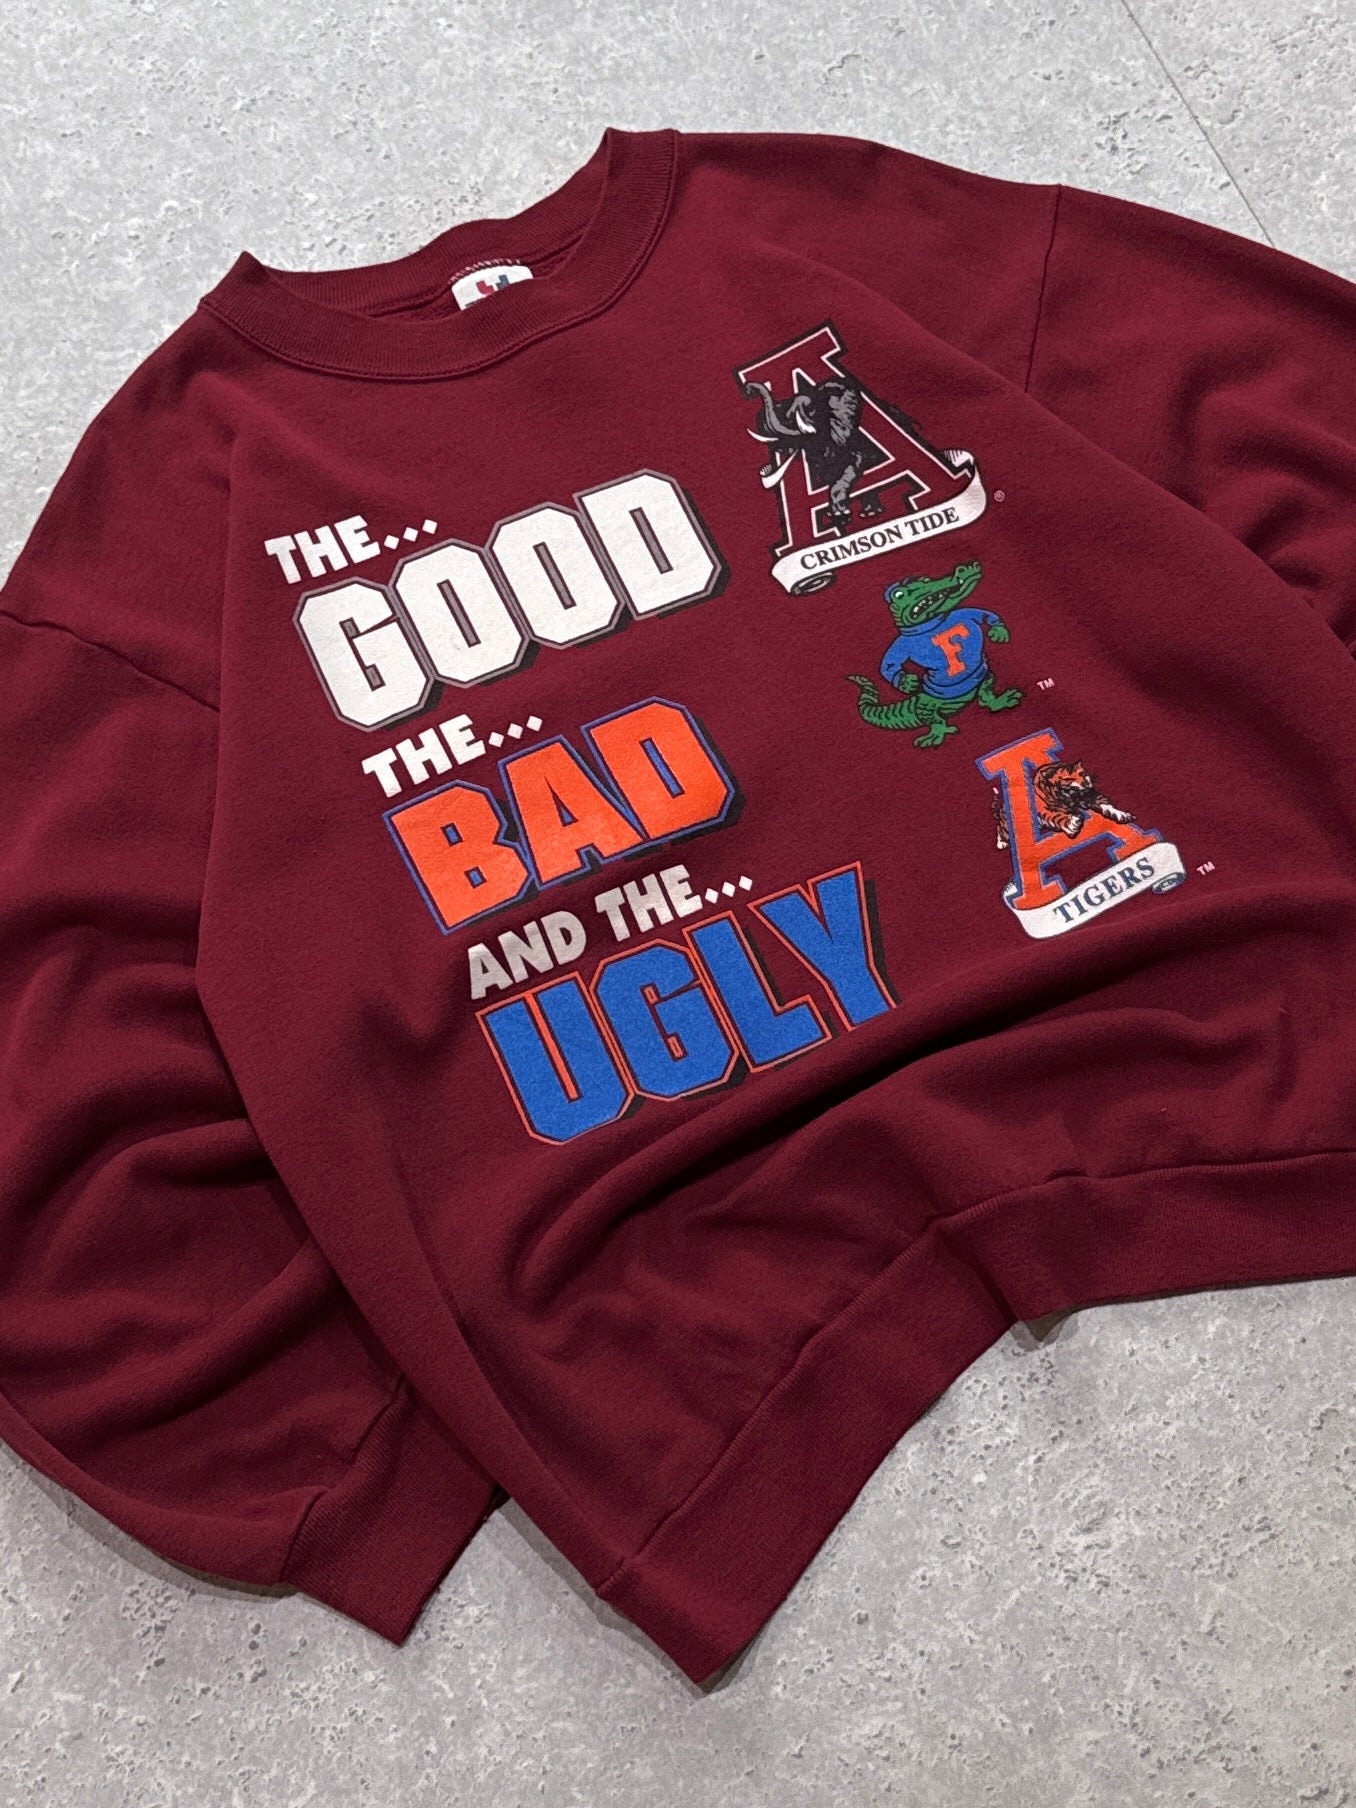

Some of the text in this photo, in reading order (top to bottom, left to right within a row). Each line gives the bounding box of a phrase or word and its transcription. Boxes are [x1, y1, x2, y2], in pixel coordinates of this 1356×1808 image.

[799, 506, 961, 571] CRIMSON TIDE
[293, 469, 726, 732] GOOD
[931, 622, 971, 677] F
[1036, 677, 1056, 691] TM
[382, 696, 739, 935] BAD
[975, 727, 1165, 911] A
[1052, 856, 1155, 924] TIGERS
[1197, 861, 1216, 876] TM
[467, 910, 587, 1000] AND
[475, 860, 898, 1145] UGLY
